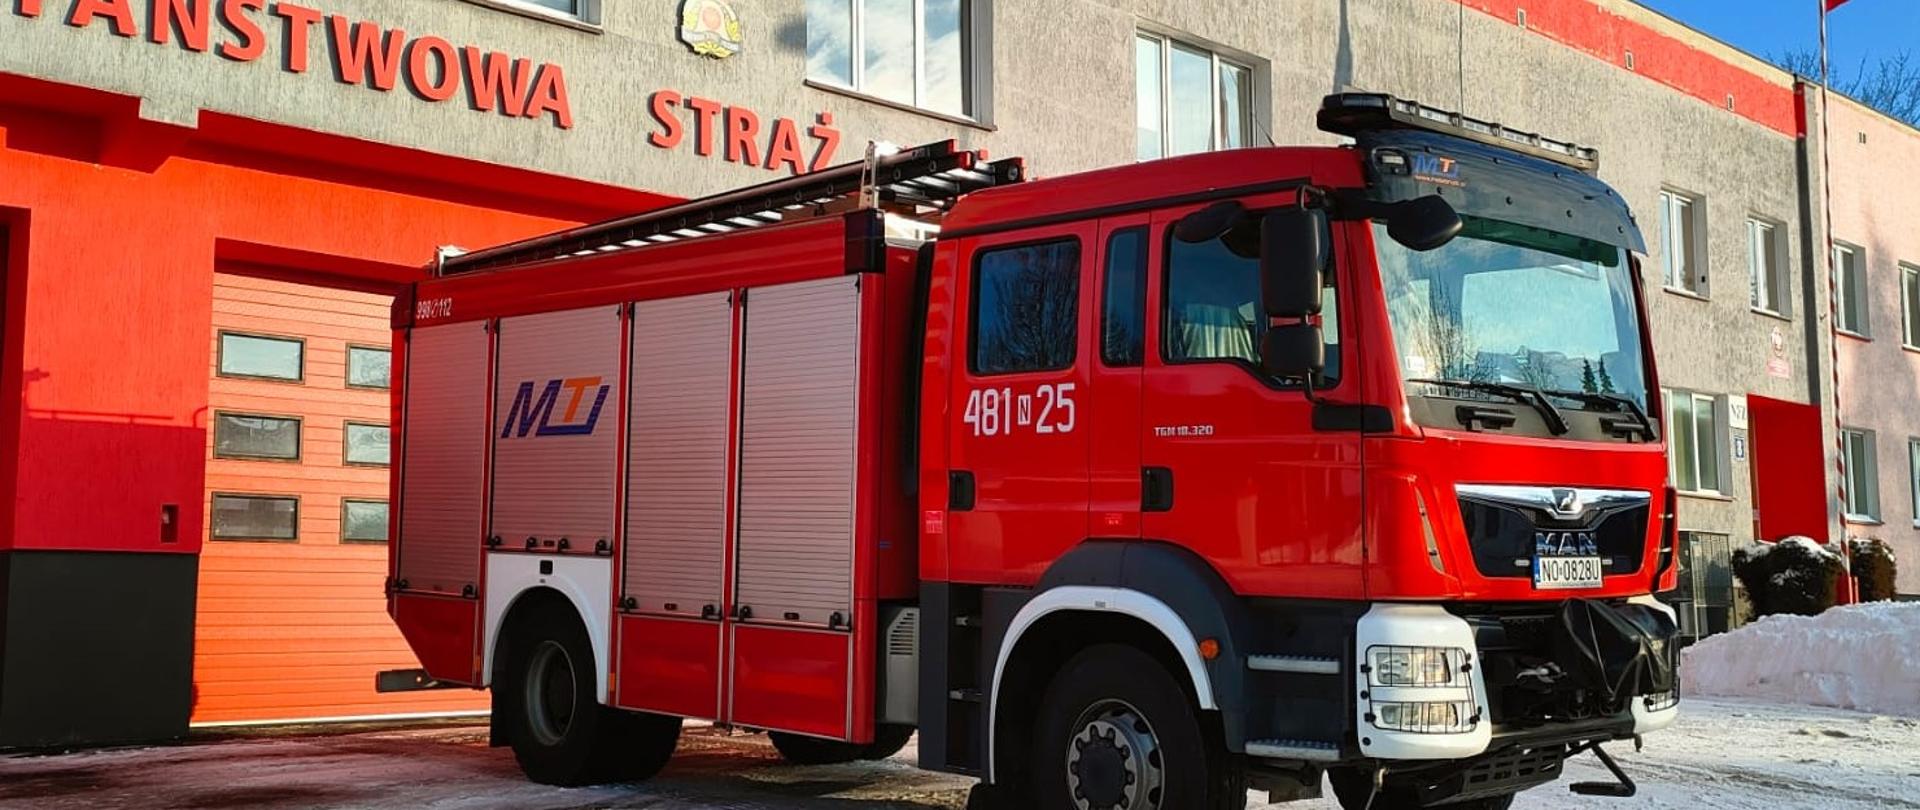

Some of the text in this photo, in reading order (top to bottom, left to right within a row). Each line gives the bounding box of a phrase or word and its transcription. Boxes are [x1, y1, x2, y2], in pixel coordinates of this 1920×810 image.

[652, 89, 841, 175] STRAŻ
[963, 382, 1075, 436] 481 N 25
[1177, 425, 1213, 436] 18.320
[1535, 532, 1598, 556] MAN
